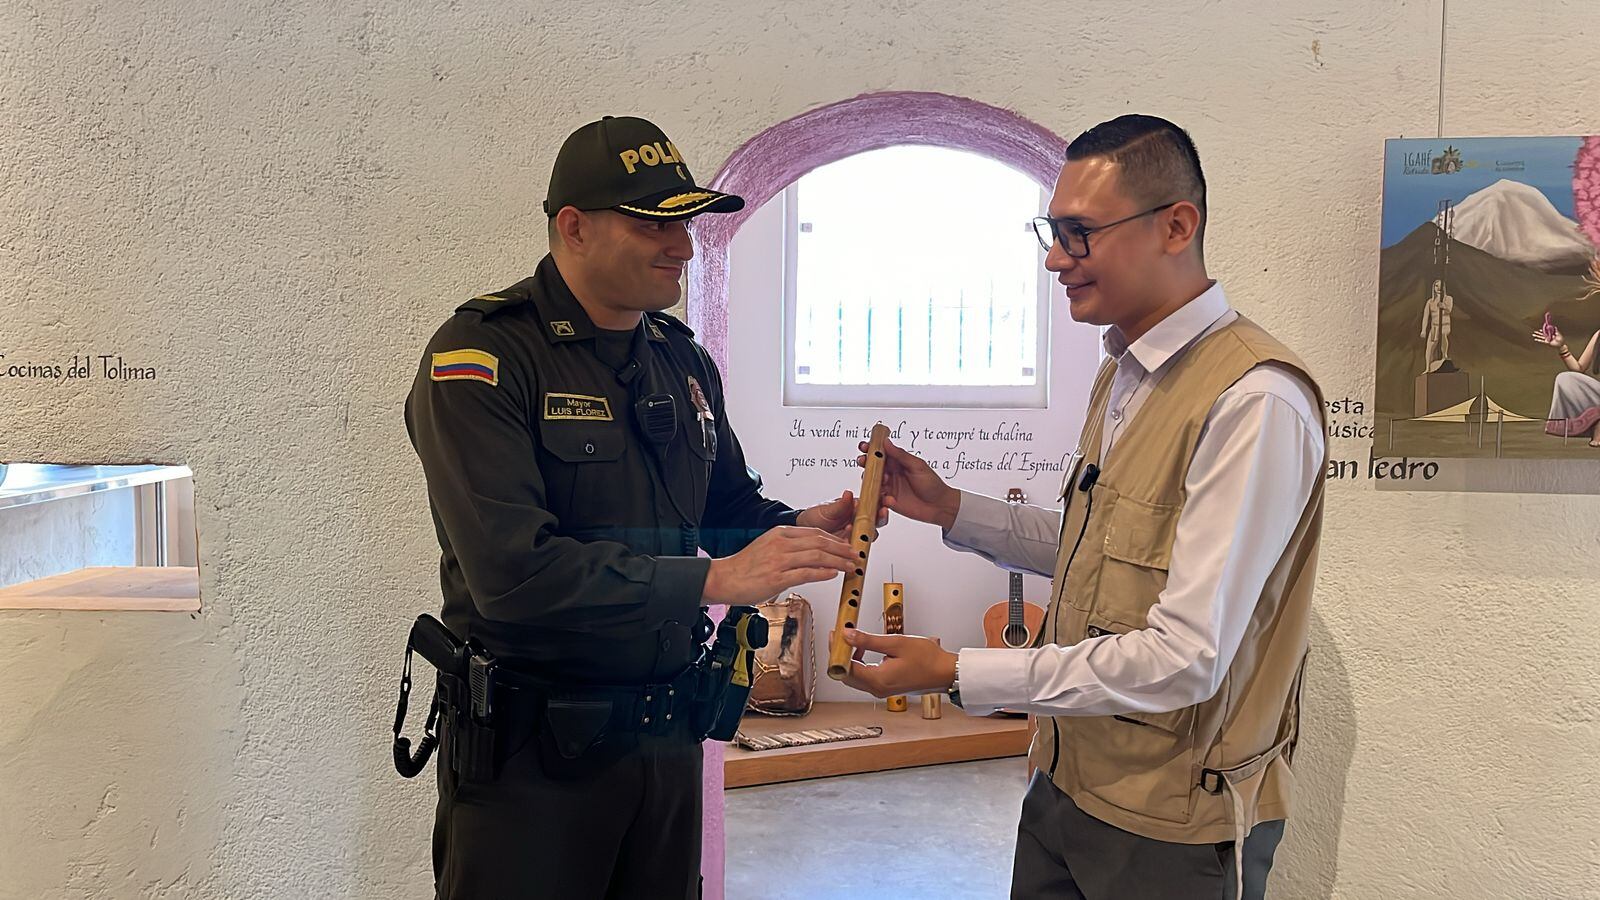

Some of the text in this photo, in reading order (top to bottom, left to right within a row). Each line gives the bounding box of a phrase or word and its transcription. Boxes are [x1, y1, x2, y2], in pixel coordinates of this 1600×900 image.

[60, 355, 90, 385] del
[97, 355, 157, 380] Tolima
[551, 407, 606, 416] LUIS FLOREZ
[566, 398, 591, 408] Mayor
[789, 419, 805, 438] Ya
[845, 426, 859, 439] mi
[910, 430, 920, 448] y
[923, 427, 934, 440] te
[978, 428, 989, 440] tu
[991, 421, 1033, 442] chalina
[785, 457, 816, 477] pues
[820, 458, 838, 468] nos
[942, 460, 950, 470] a
[945, 451, 993, 480] fiestas
[996, 452, 1018, 471] del
[1017, 452, 1070, 480] Espinal
